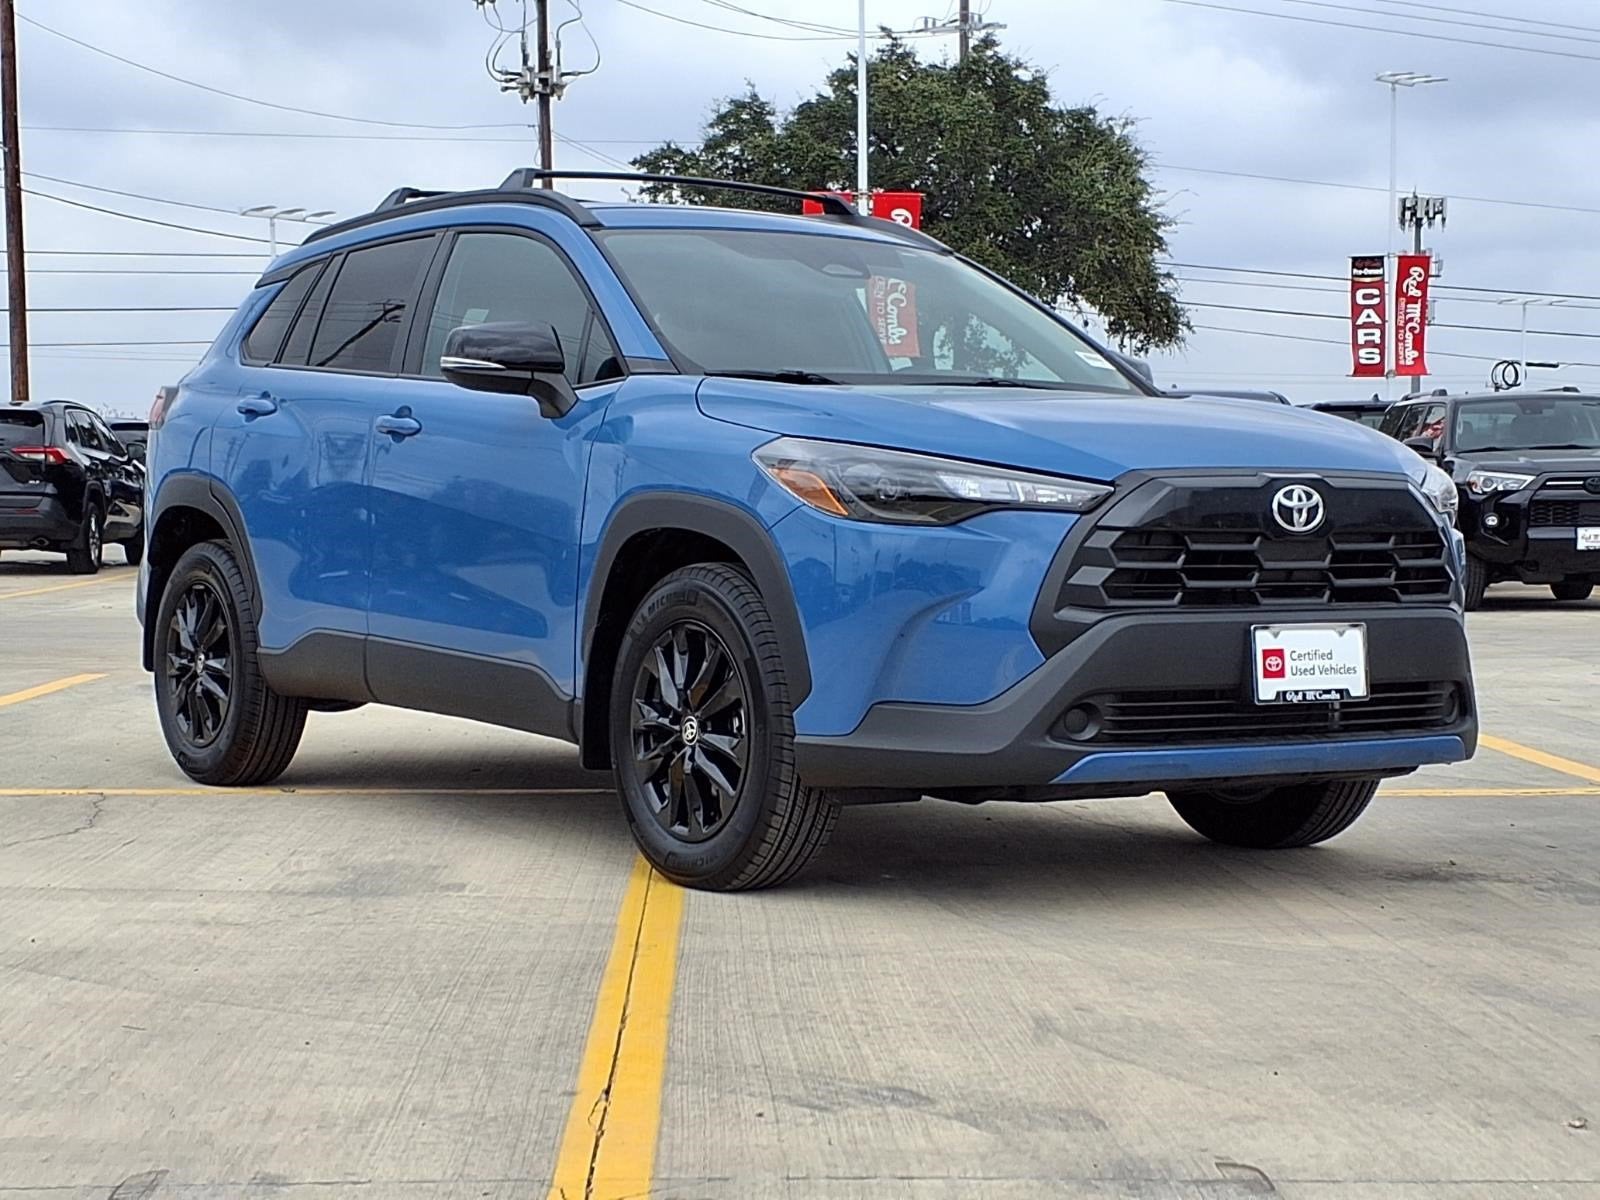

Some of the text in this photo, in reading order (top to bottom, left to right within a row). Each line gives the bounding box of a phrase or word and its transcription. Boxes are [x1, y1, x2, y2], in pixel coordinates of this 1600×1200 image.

[1402, 266, 1425, 366] Red McCombs
[1355, 288, 1383, 365] CARS
[1398, 329, 1405, 340] TO
[1289, 648, 1333, 661] Certified
[1290, 663, 1358, 676] Used Vehicles
